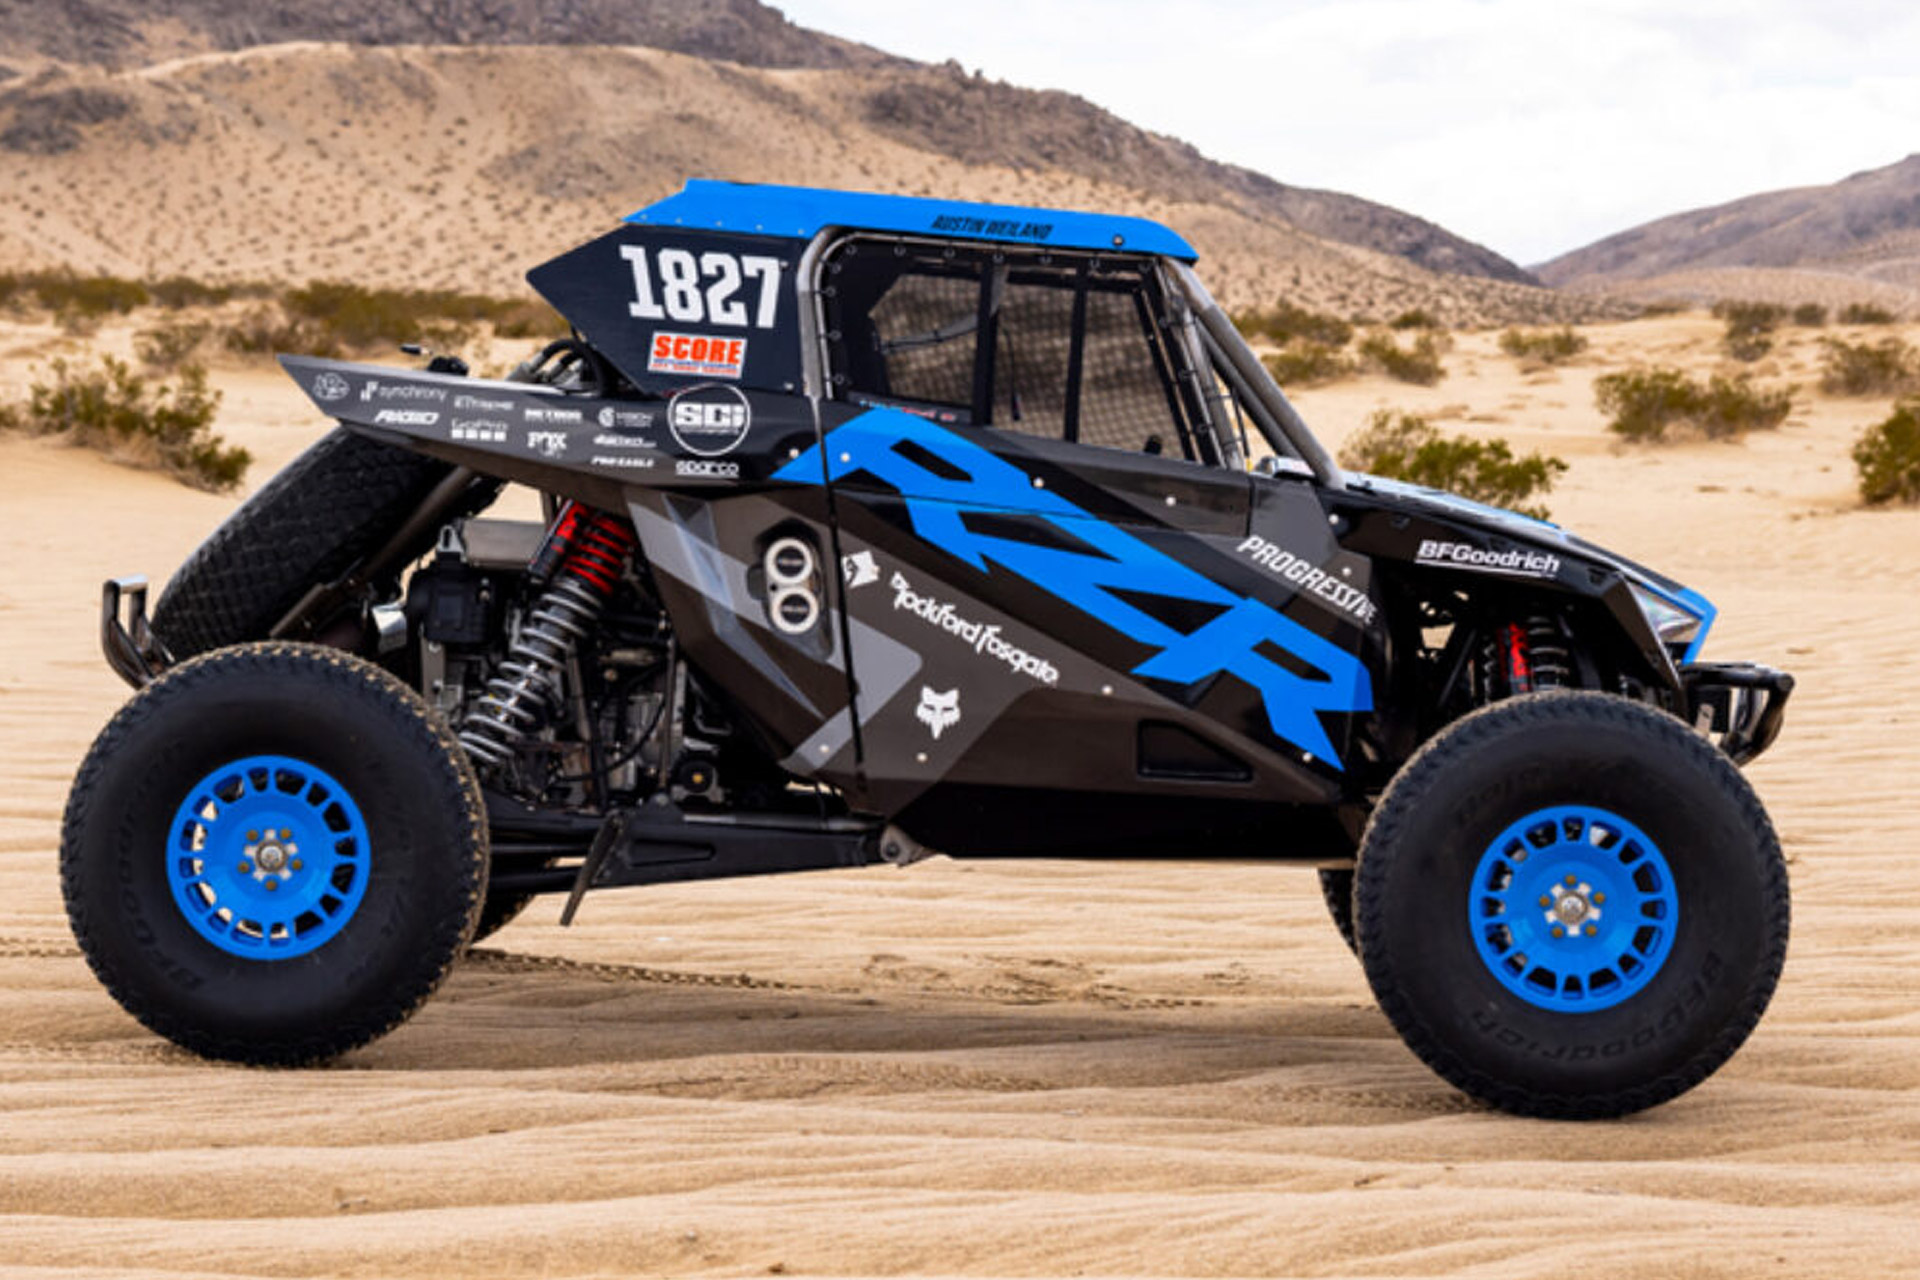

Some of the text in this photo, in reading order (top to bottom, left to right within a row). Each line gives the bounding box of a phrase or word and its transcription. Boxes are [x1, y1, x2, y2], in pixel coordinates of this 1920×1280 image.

[931, 215, 984, 234] AUSTIN
[619, 244, 780, 329] 1827
[654, 335, 741, 365] SCORE
[1417, 540, 1561, 573] BFGoodrich
